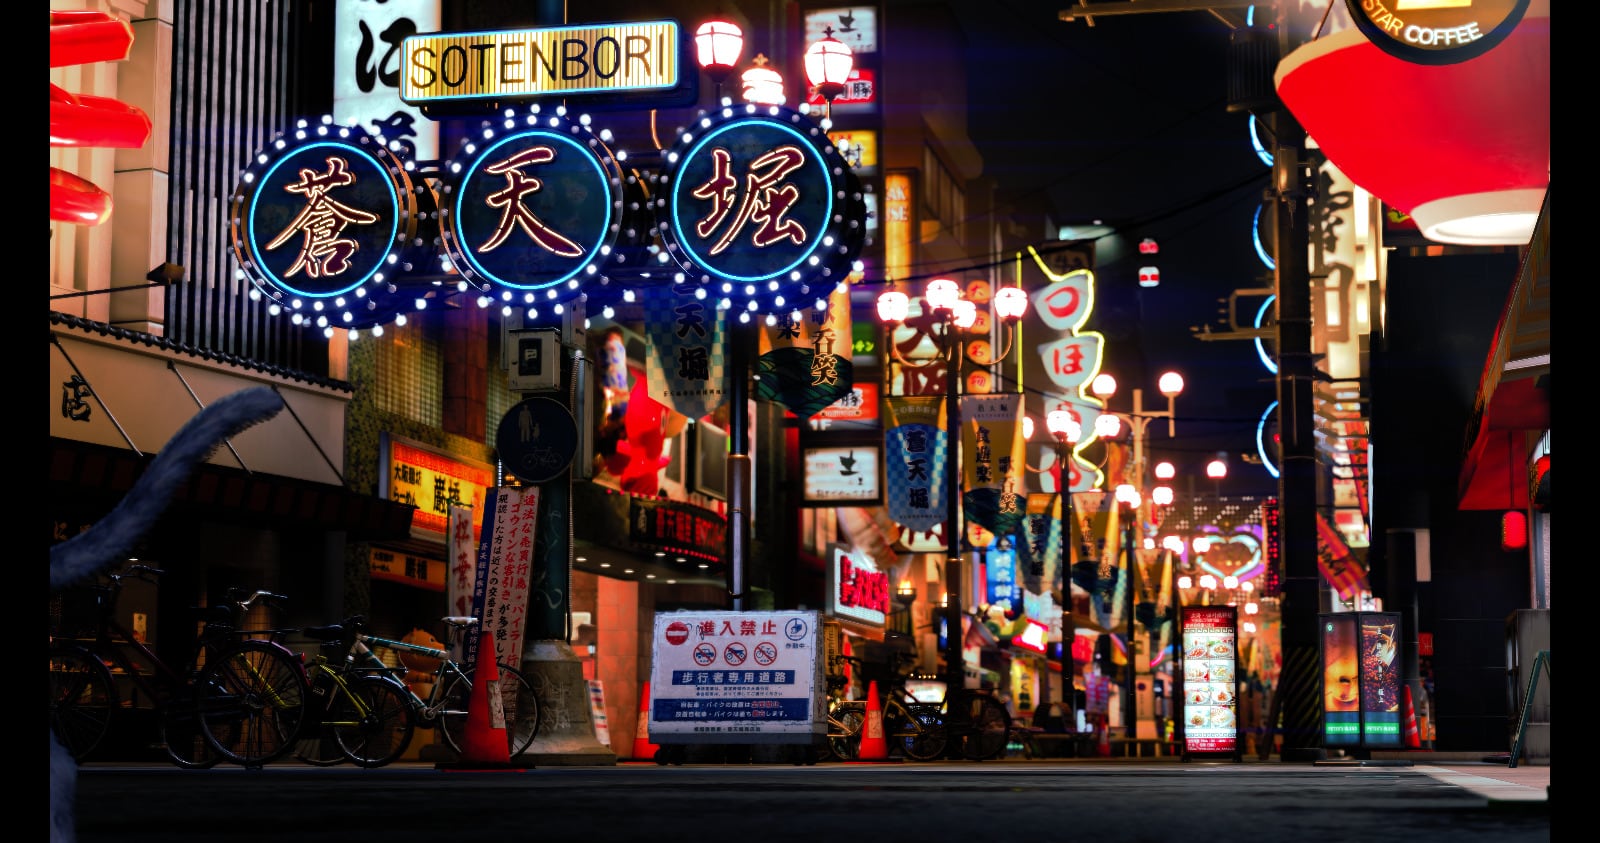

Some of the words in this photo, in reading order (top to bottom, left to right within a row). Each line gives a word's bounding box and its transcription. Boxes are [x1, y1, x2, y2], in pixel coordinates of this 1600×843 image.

[1404, 22, 1484, 46] COFFEE
[410, 33, 665, 90] SOTENBORI
[265, 145, 806, 278] 蒼天堀
[906, 429, 930, 509] 蒼天堀
[700, 620, 777, 636] 進入禁止
[682, 672, 787, 684] 歩行者専用道路
